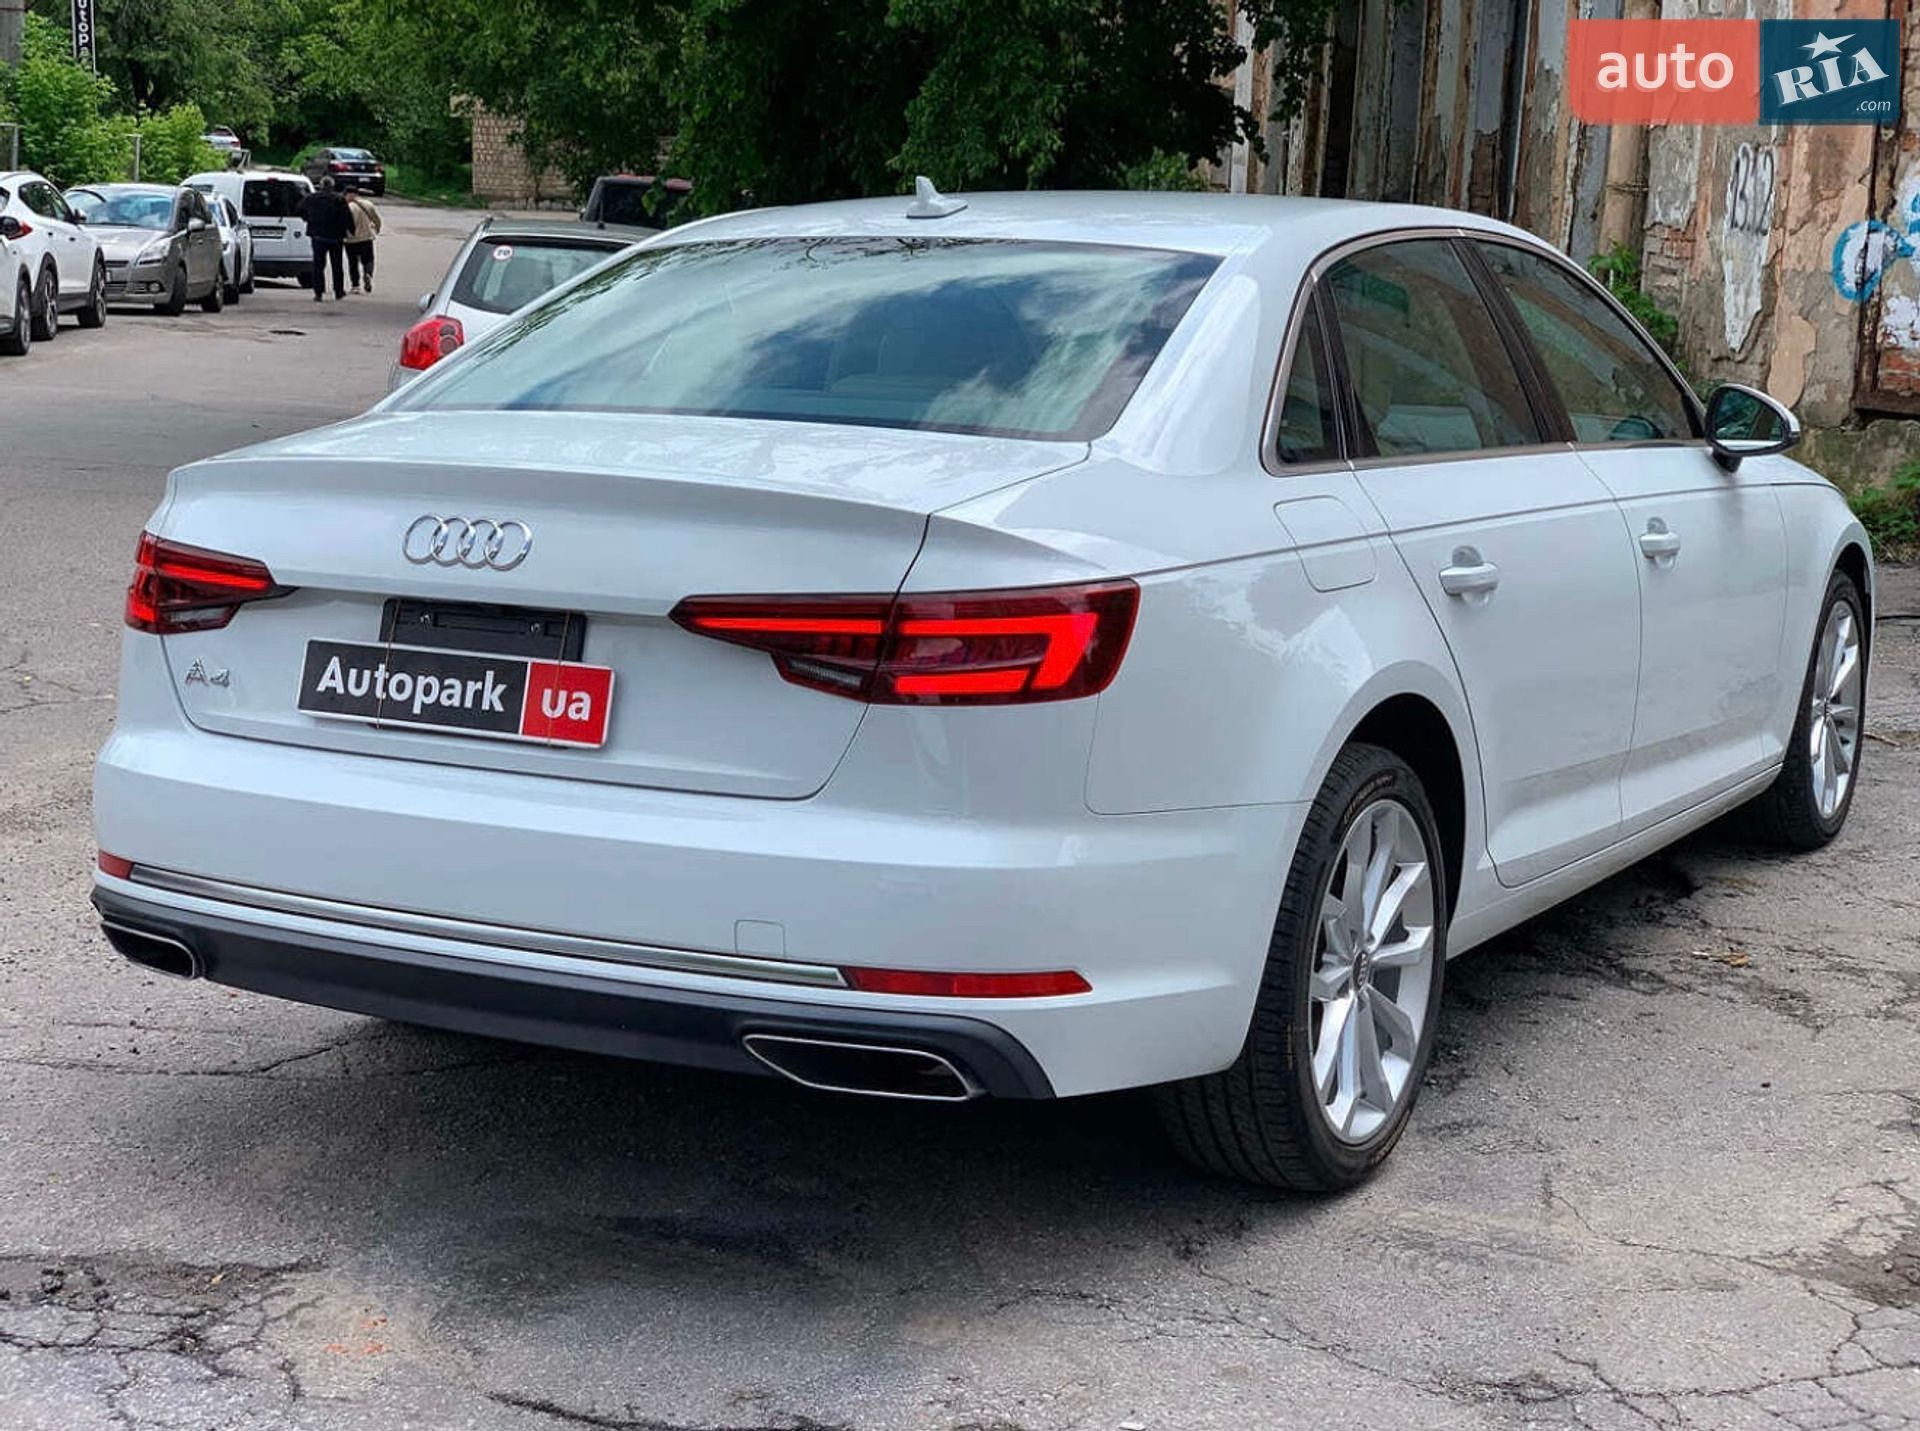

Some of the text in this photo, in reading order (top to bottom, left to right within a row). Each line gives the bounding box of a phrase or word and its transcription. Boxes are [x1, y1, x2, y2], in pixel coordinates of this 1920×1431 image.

[186, 659, 230, 688] A4
[317, 655, 591, 721] Autopark ua
